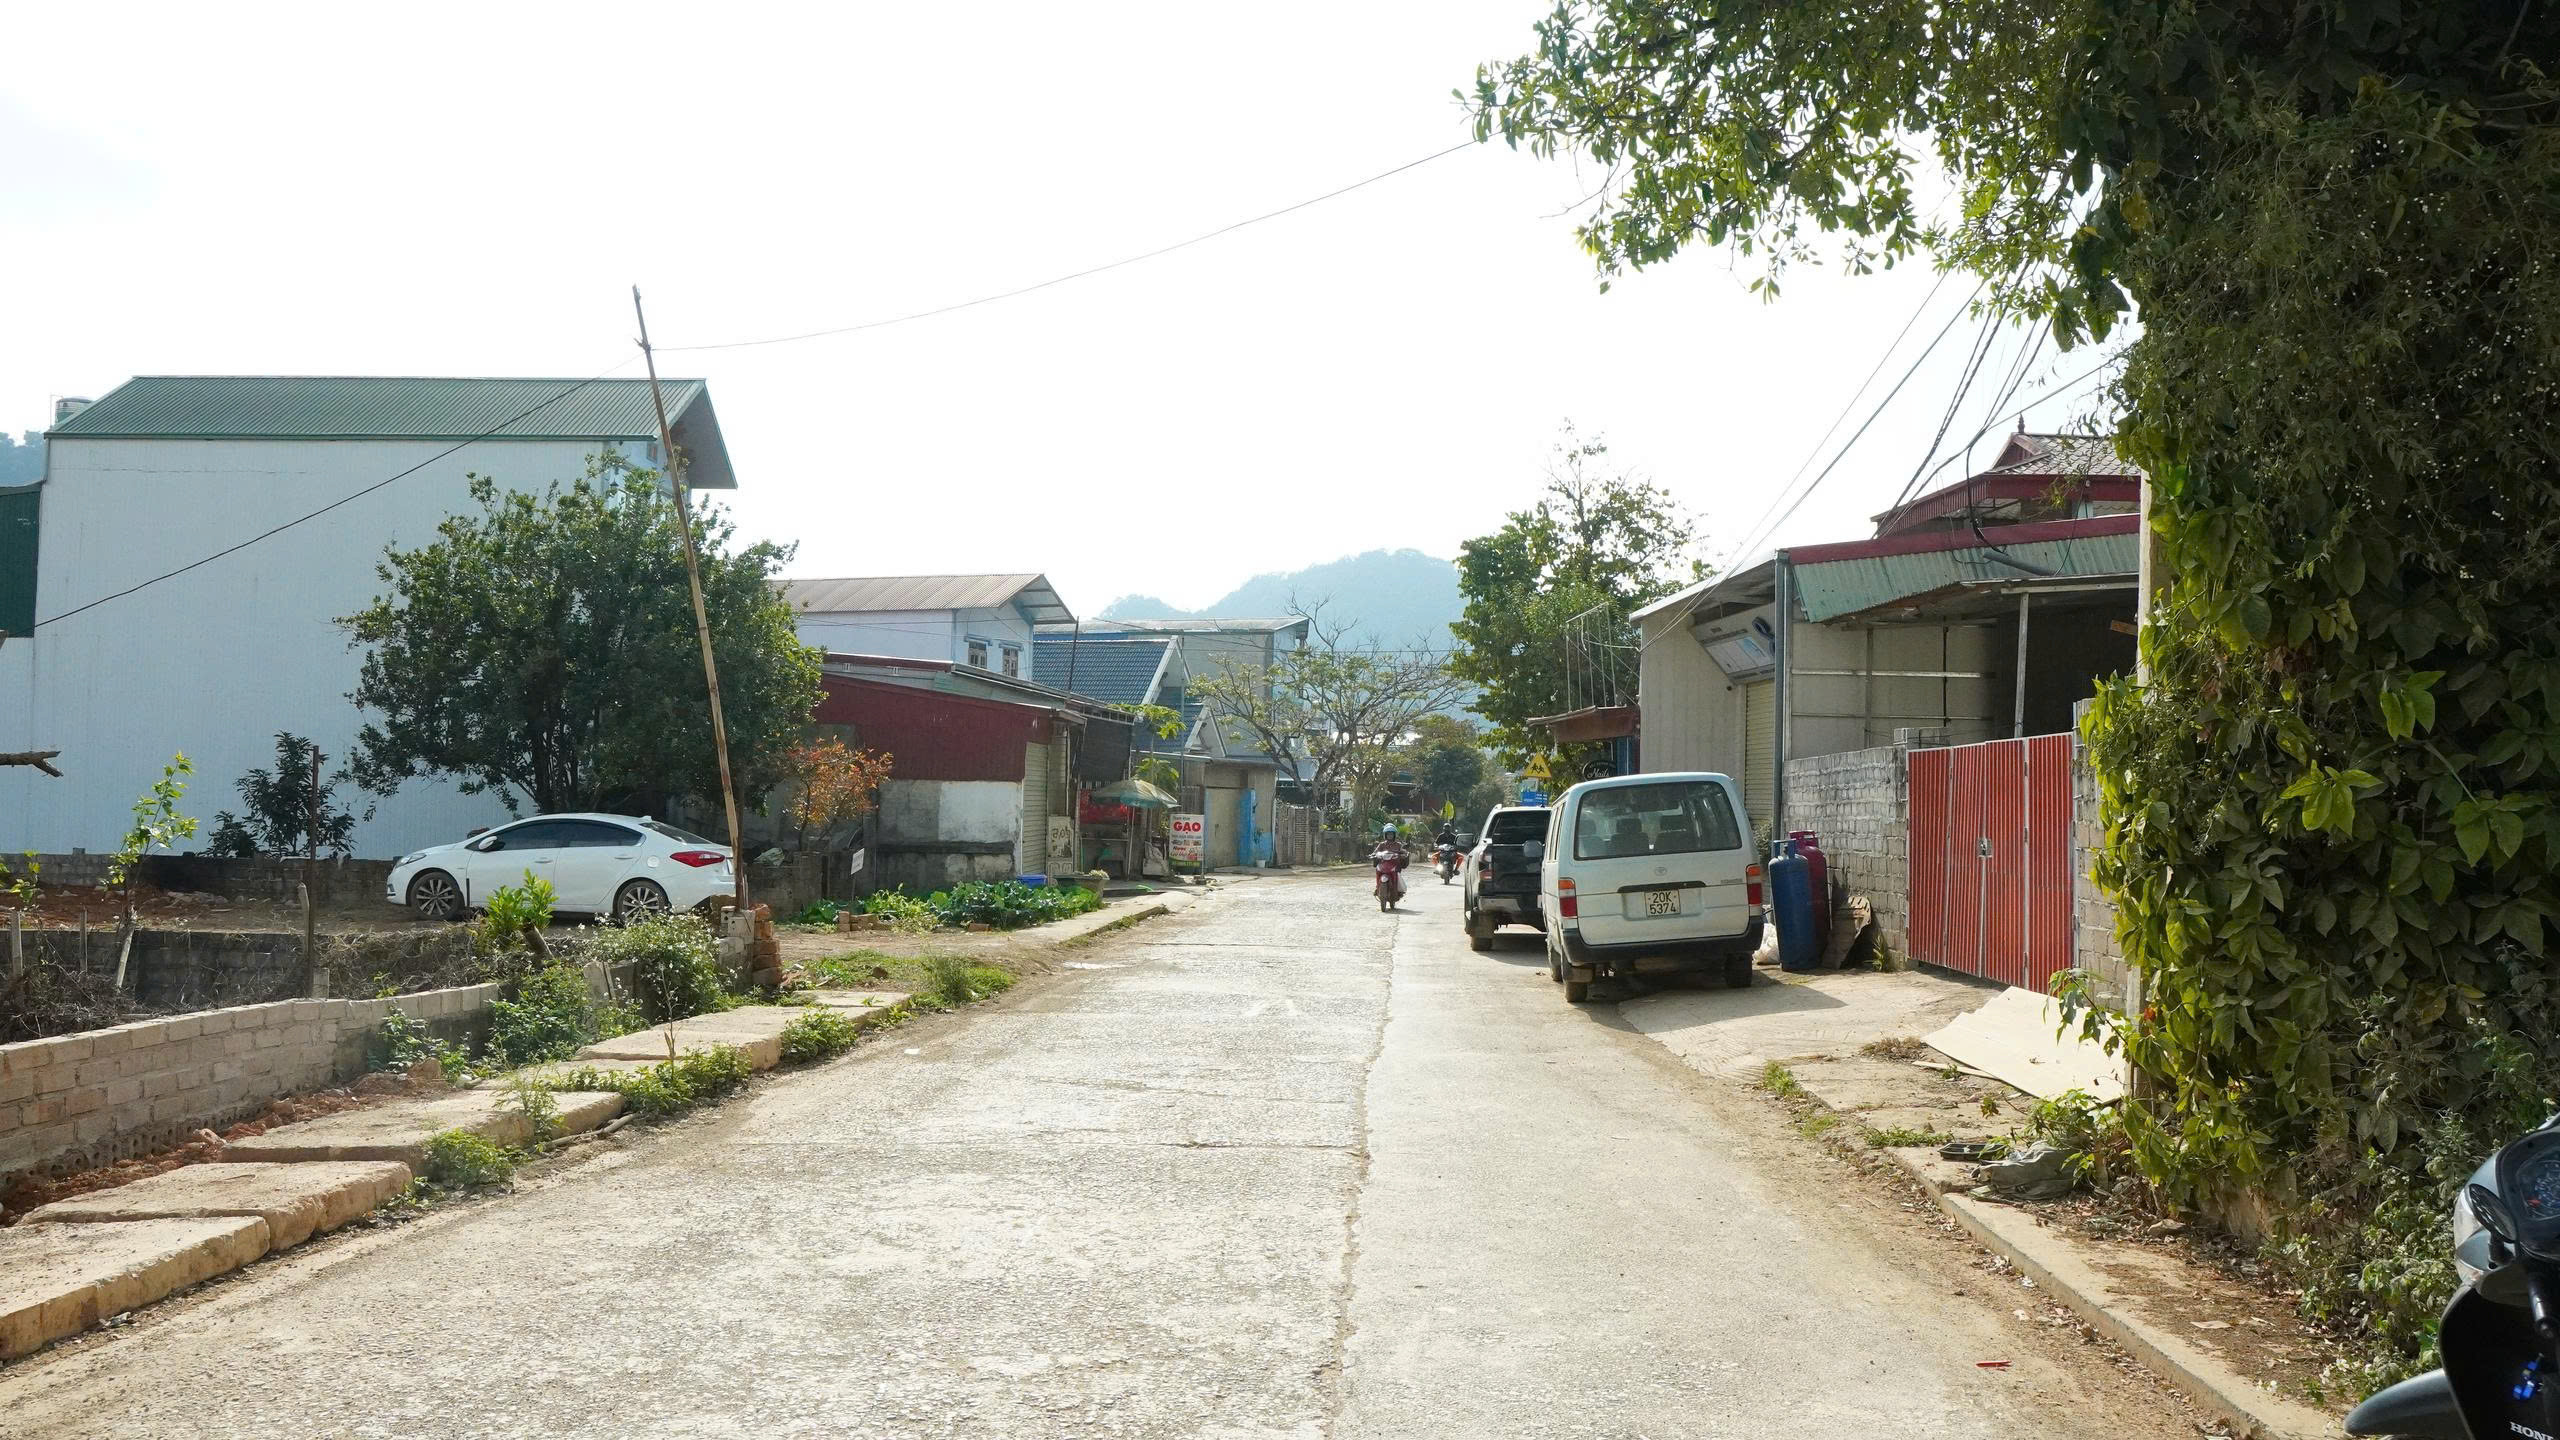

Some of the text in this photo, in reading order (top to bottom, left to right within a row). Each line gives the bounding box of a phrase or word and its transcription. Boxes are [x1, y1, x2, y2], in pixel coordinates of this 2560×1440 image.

[1173, 821, 1201, 834] GẠO
[1652, 891, 1672, 903] 20K
[1649, 902, 1677, 915] 5374
